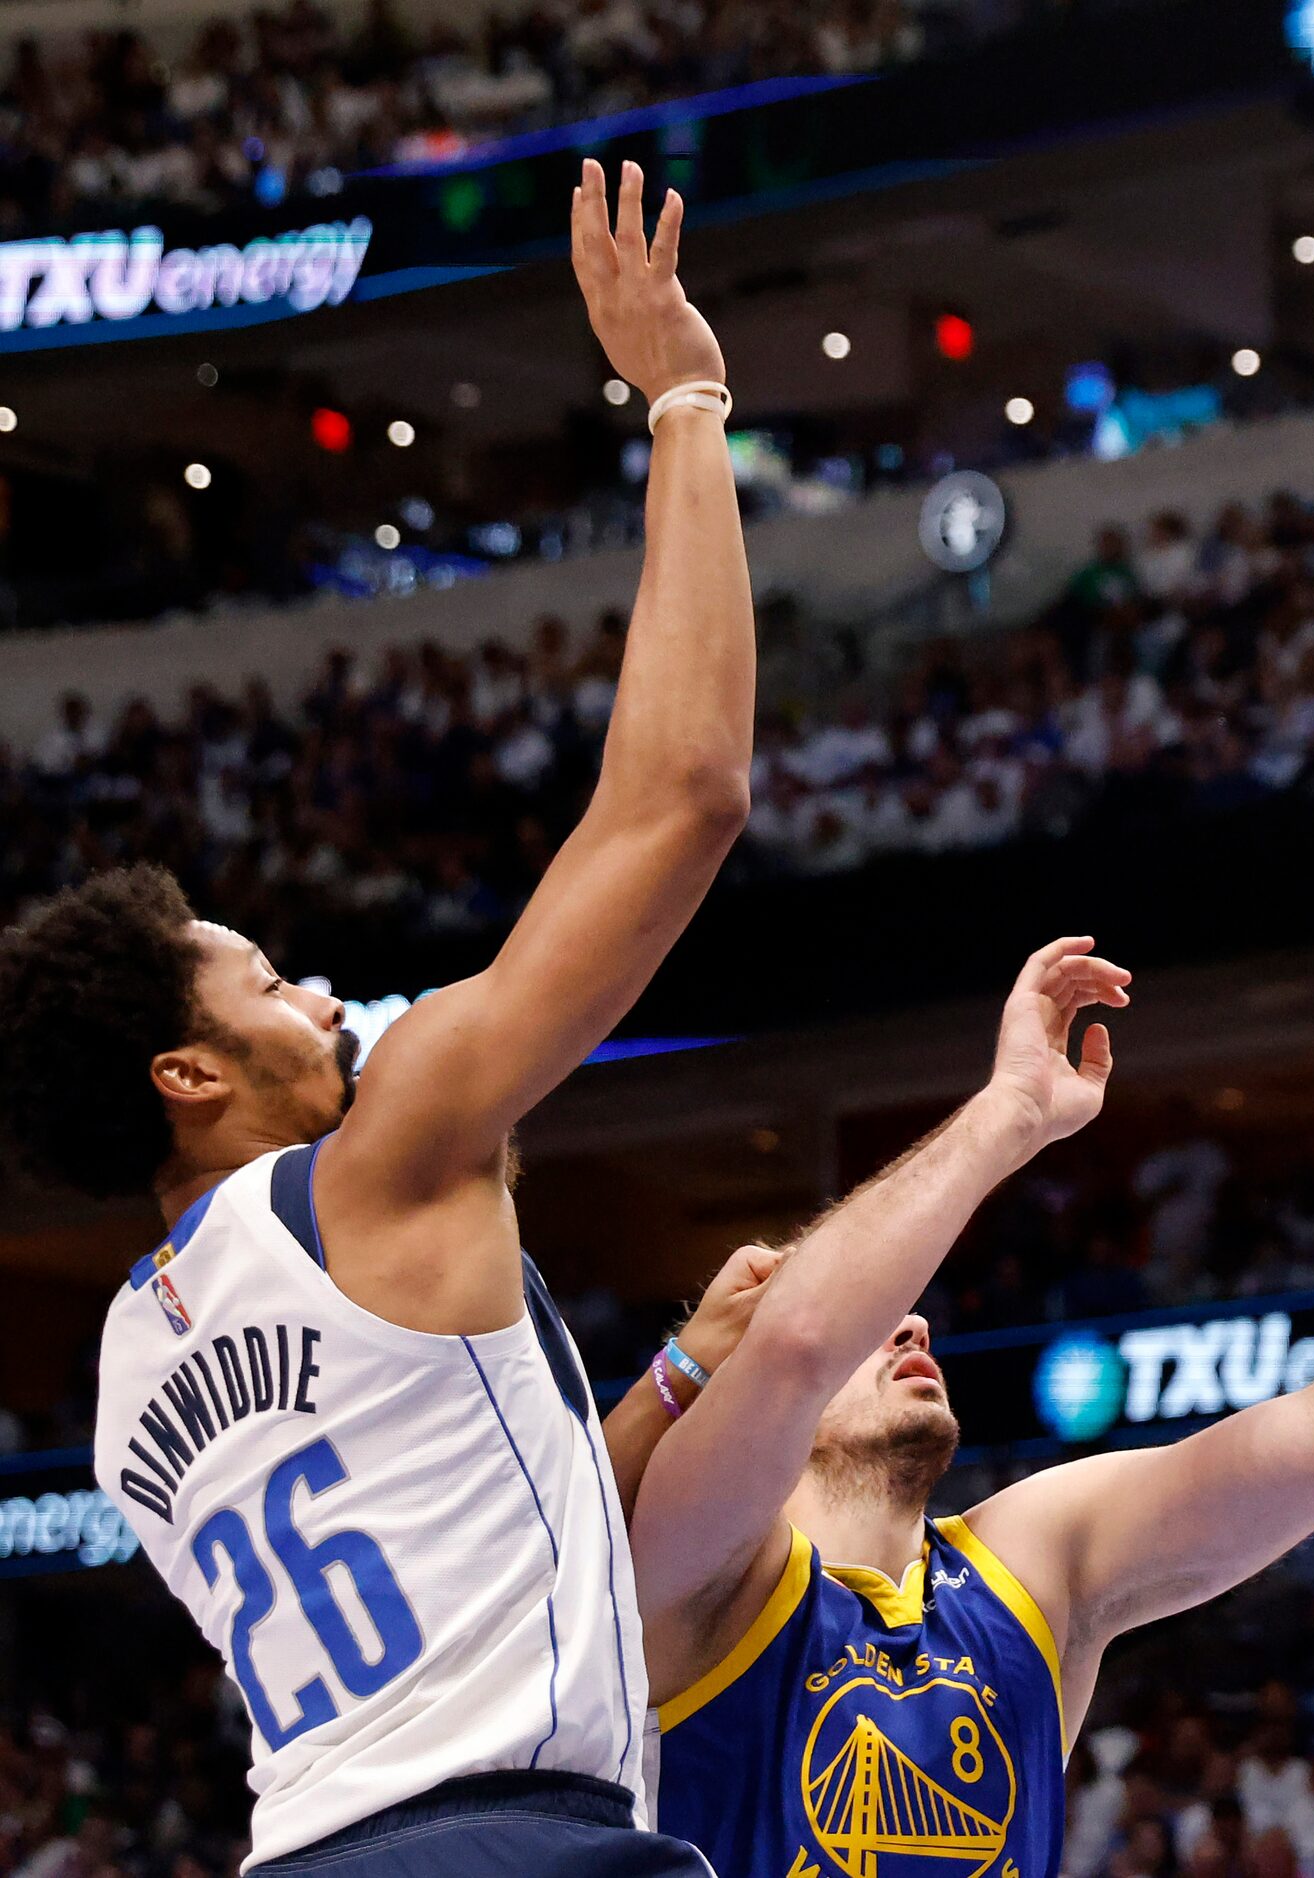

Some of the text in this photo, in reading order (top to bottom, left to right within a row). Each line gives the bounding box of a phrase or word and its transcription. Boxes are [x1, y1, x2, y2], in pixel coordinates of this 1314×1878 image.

[120, 1324, 321, 1525] DINWIDDIE
[191, 1433, 426, 1755] 26
[805, 1643, 998, 1708] GOLDEN STAE
[950, 1716, 984, 1783] 8
